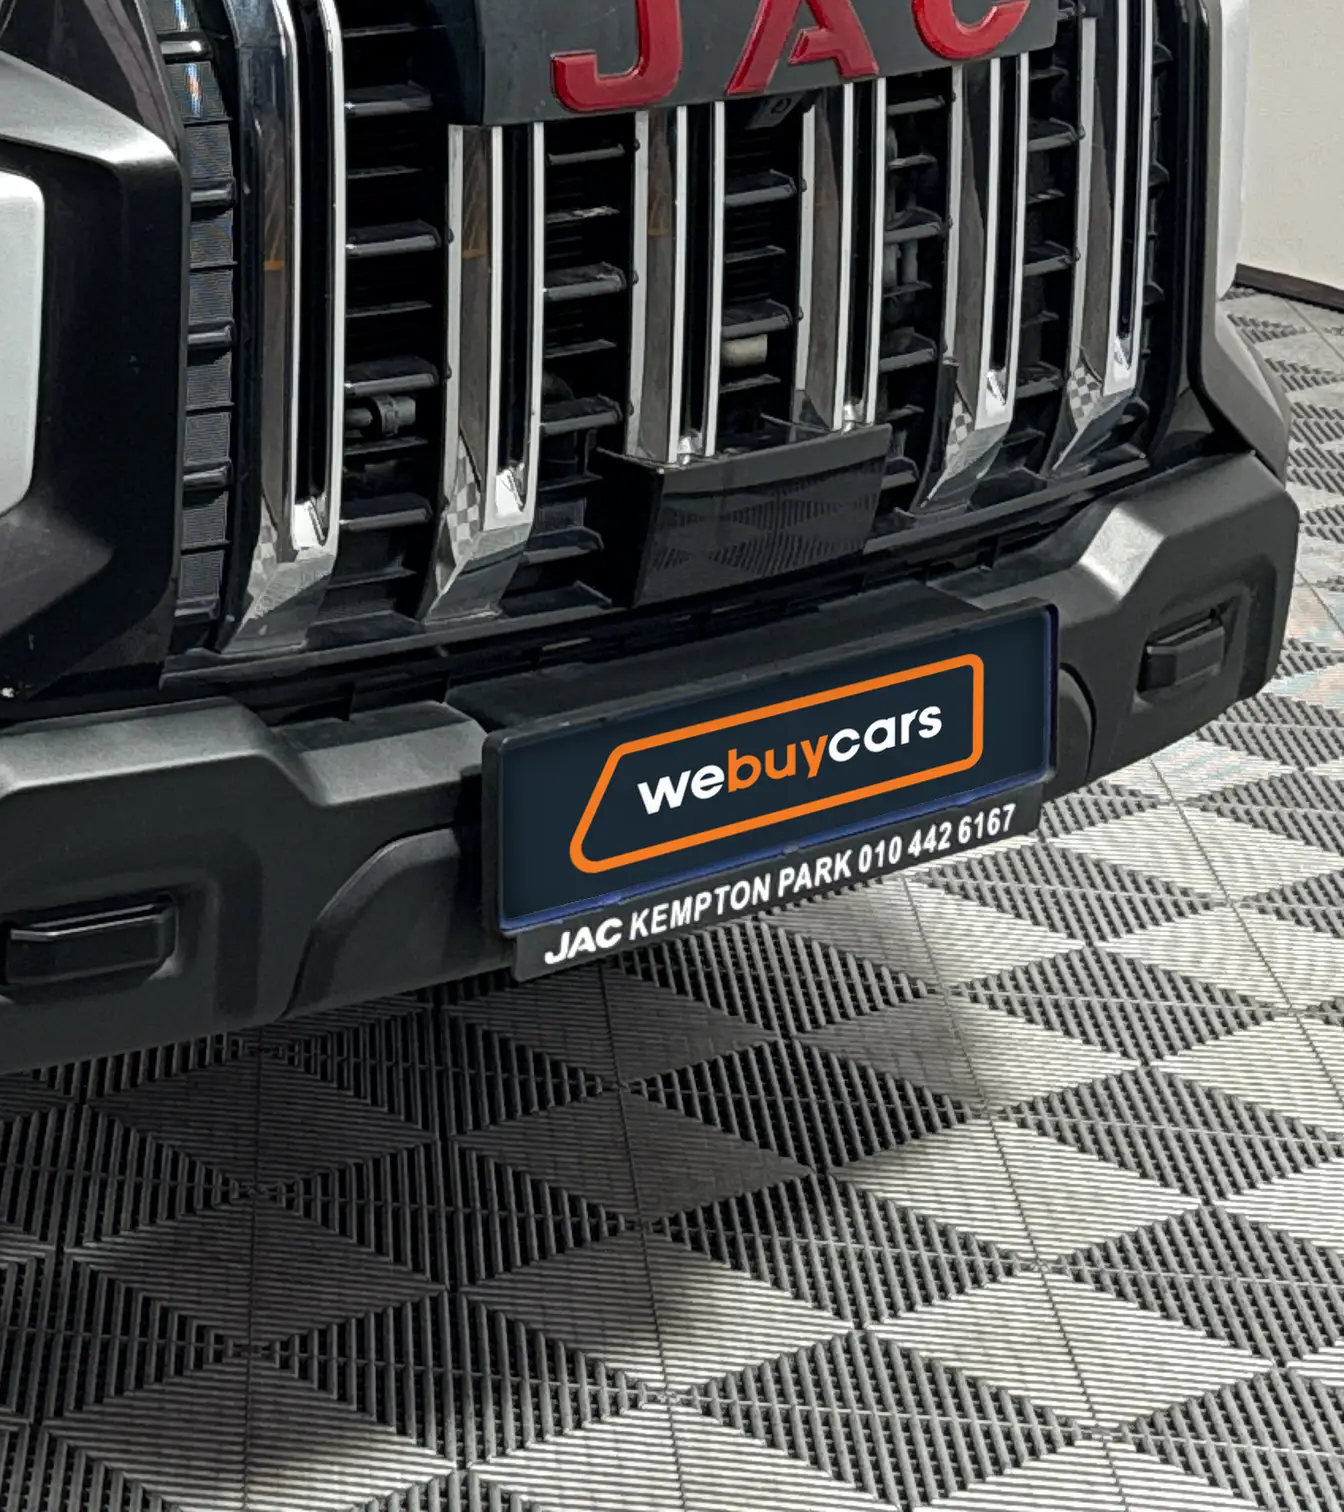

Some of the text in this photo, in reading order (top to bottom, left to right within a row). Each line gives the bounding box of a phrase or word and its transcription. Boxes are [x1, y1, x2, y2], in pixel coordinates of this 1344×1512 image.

[544, 802, 1016, 965] JAC KEMPTON PARK 010 442 6167
